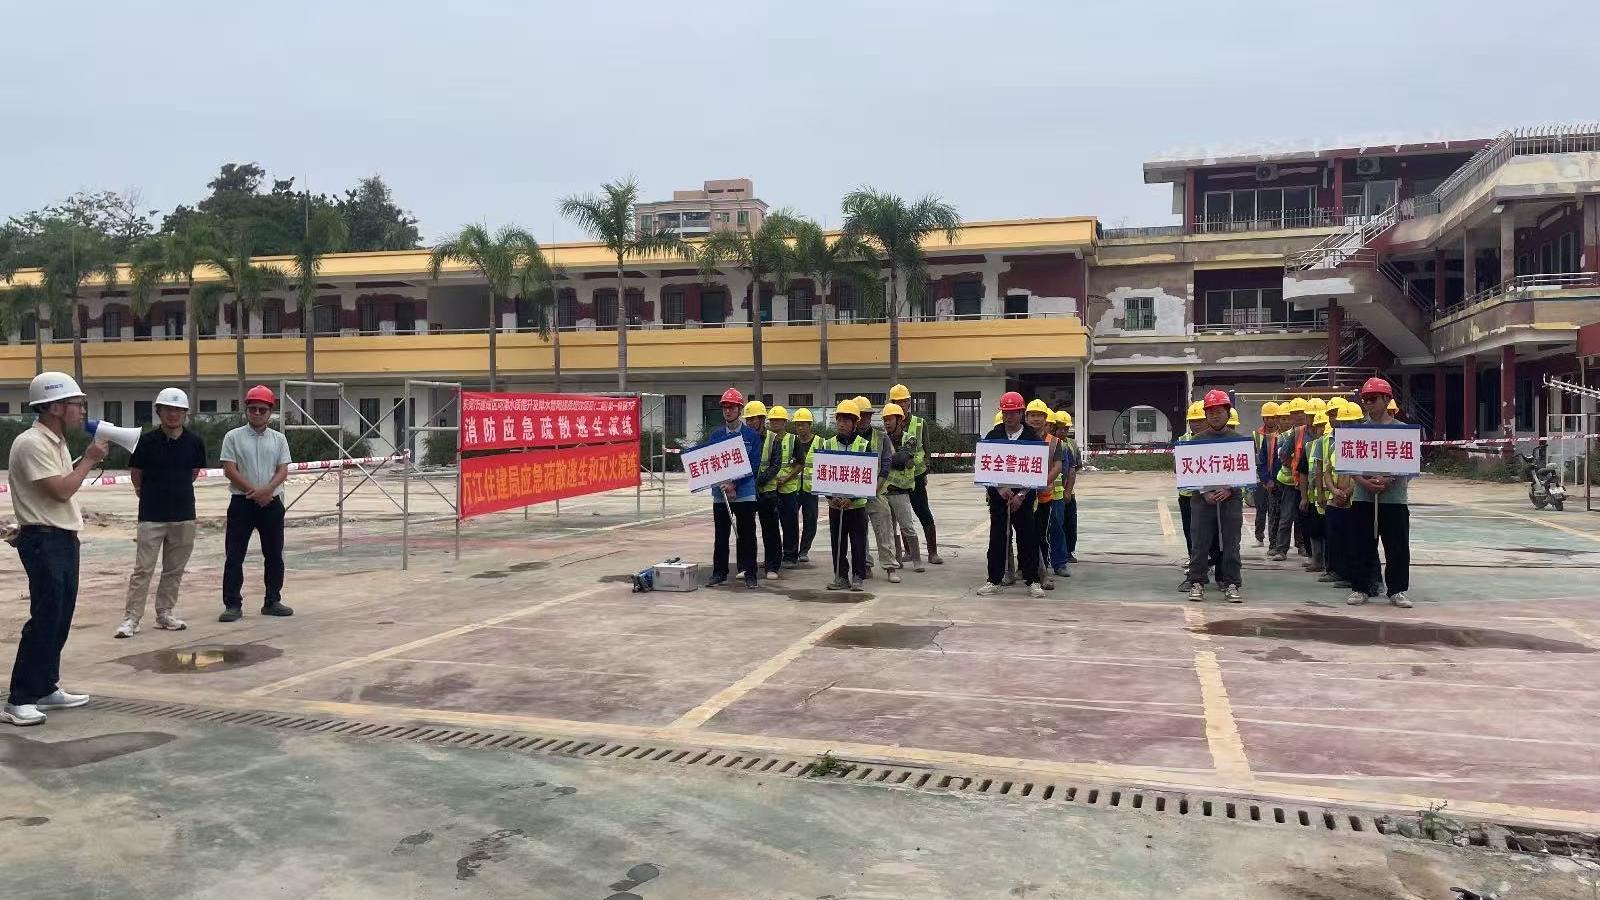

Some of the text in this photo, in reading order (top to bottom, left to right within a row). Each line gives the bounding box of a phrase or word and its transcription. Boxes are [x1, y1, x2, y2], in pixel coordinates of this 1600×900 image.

[465, 416, 633, 443] 消防应急疏散逃生演练
[1341, 440, 1414, 460] 疏散引导组
[689, 448, 744, 478] 医疗救护组
[980, 454, 1043, 473] 安全警戒组
[1182, 454, 1250, 475] 灭火行动组
[463, 452, 637, 504] 万江住建局应急疏散逃生和灭火演练
[816, 465, 873, 484] 通讯联络组
